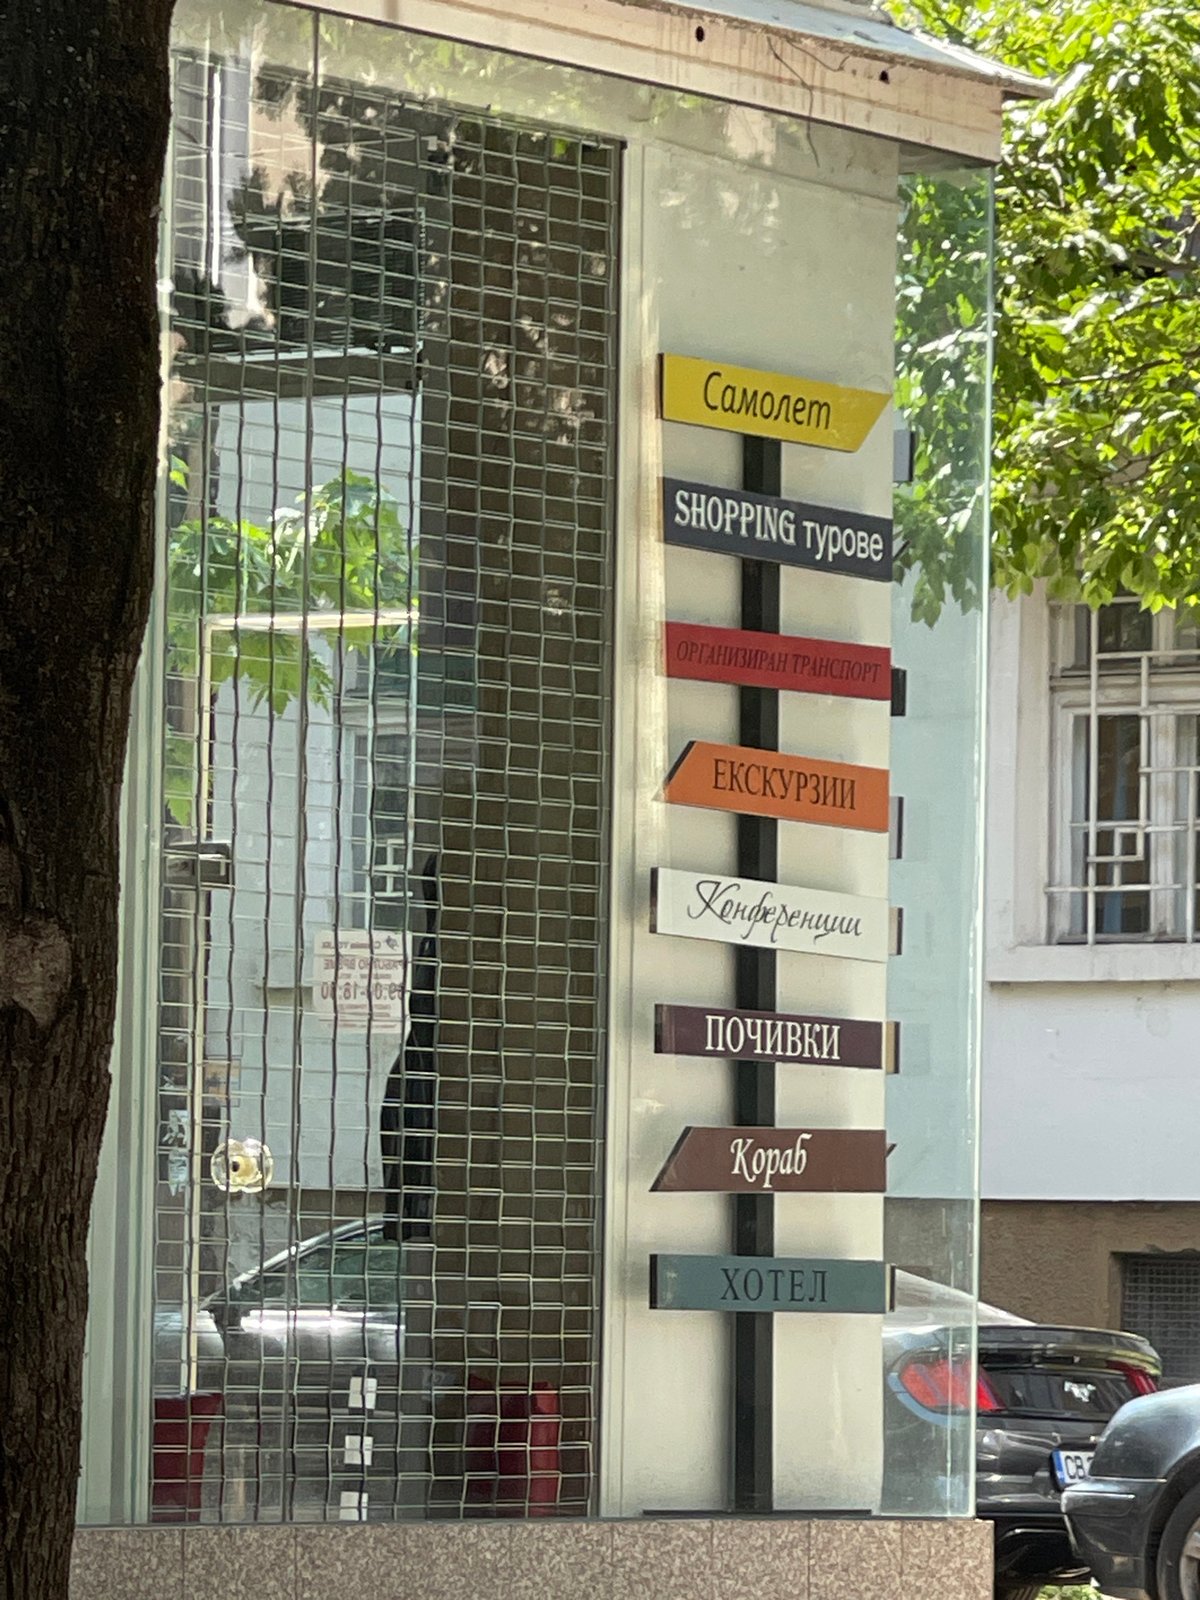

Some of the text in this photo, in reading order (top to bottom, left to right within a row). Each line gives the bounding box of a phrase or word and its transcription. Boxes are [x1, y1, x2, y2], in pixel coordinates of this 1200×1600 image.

[703, 371, 831, 430] Самолет
[674, 489, 884, 562] SHOPPING турове
[676, 640, 882, 684] ОРГАНИЗИРАН ТРАНСПОРТ
[712, 758, 857, 810] ЕКСКУРЗИИ
[687, 879, 863, 943] Конференции
[705, 1014, 841, 1060] ПОЧИВКИ
[730, 1133, 813, 1188] Кораб
[720, 1268, 828, 1303] ХОТЕЛ
